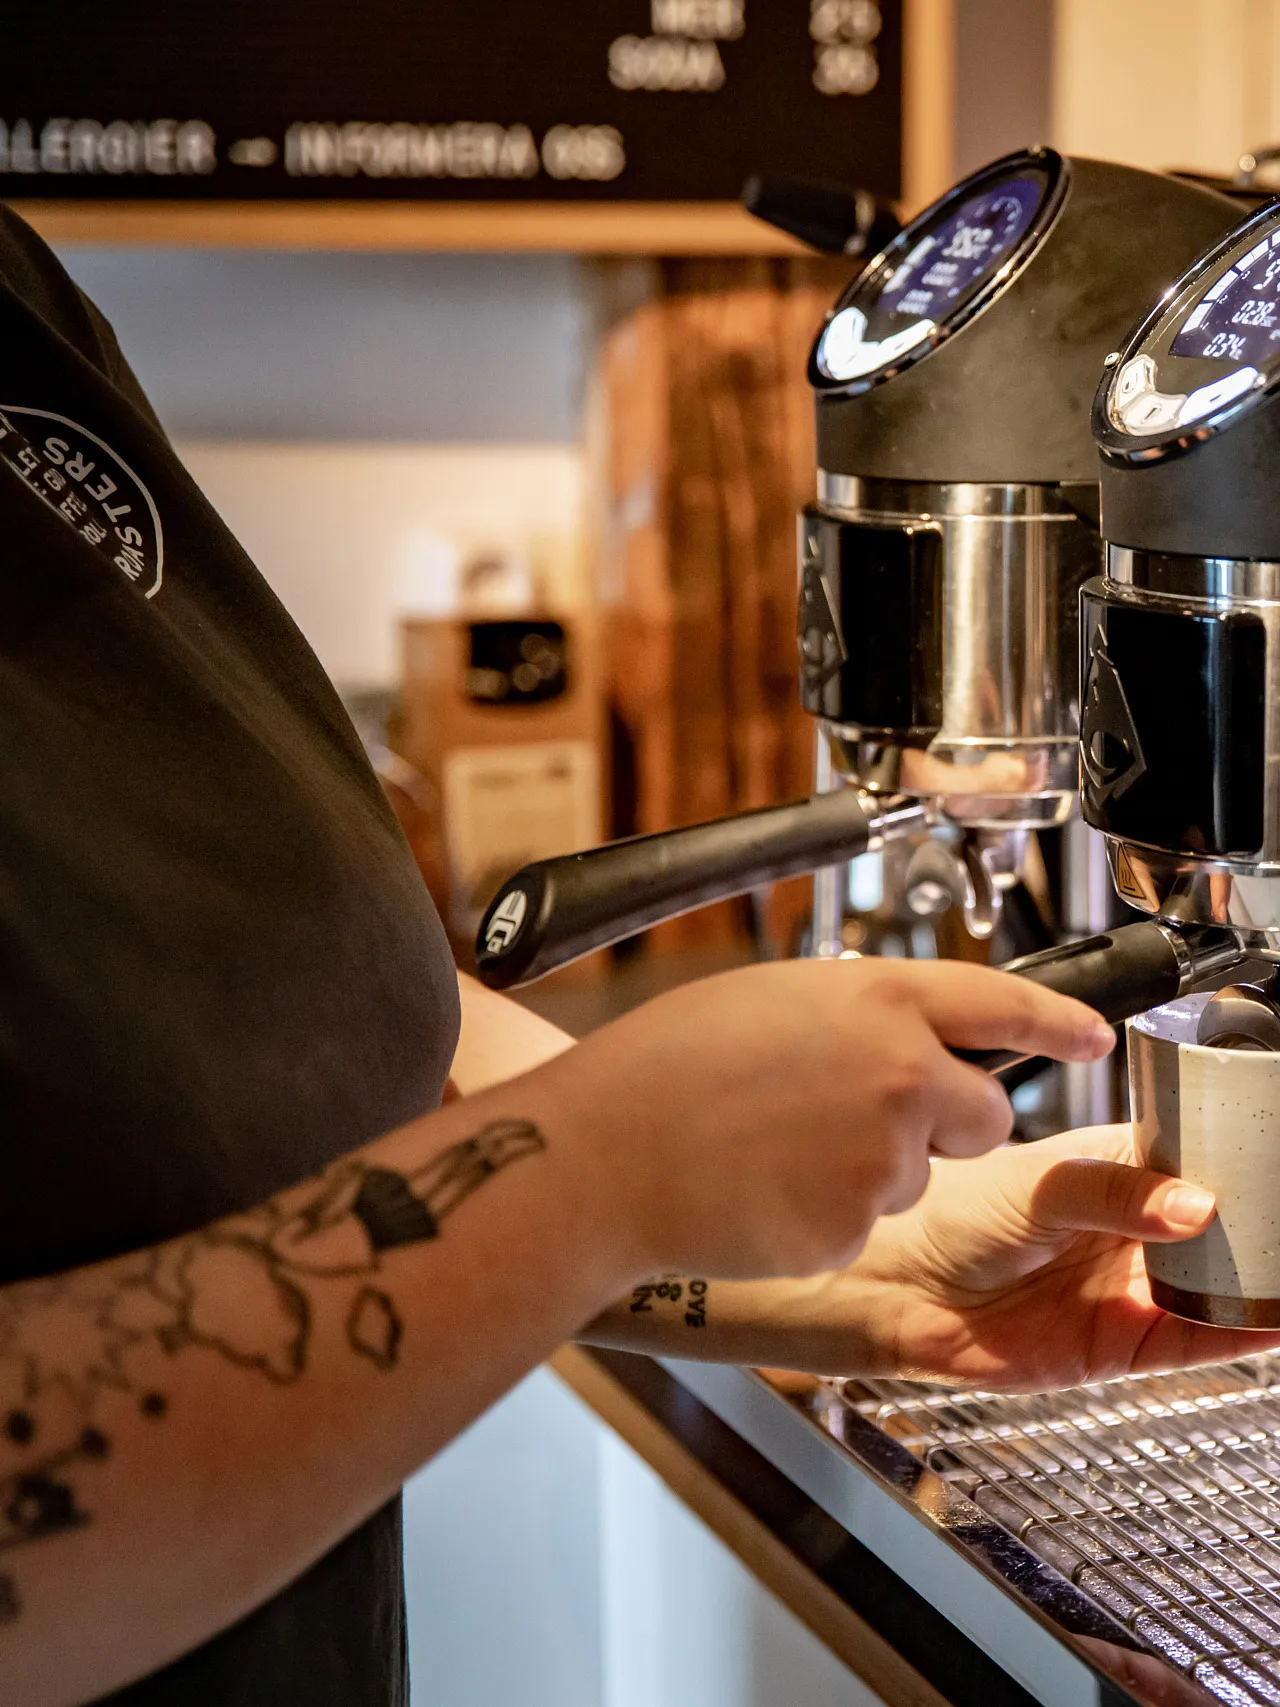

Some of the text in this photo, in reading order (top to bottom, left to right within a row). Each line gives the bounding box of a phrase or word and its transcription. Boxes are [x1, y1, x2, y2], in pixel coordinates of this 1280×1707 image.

[607, 34, 727, 91] SODA
[0, 118, 217, 175] LERGIER
[284, 121, 540, 179] INFORMERA
[43, 437, 145, 581] ROASTERS
[684, 1279, 708, 1328] OVE
